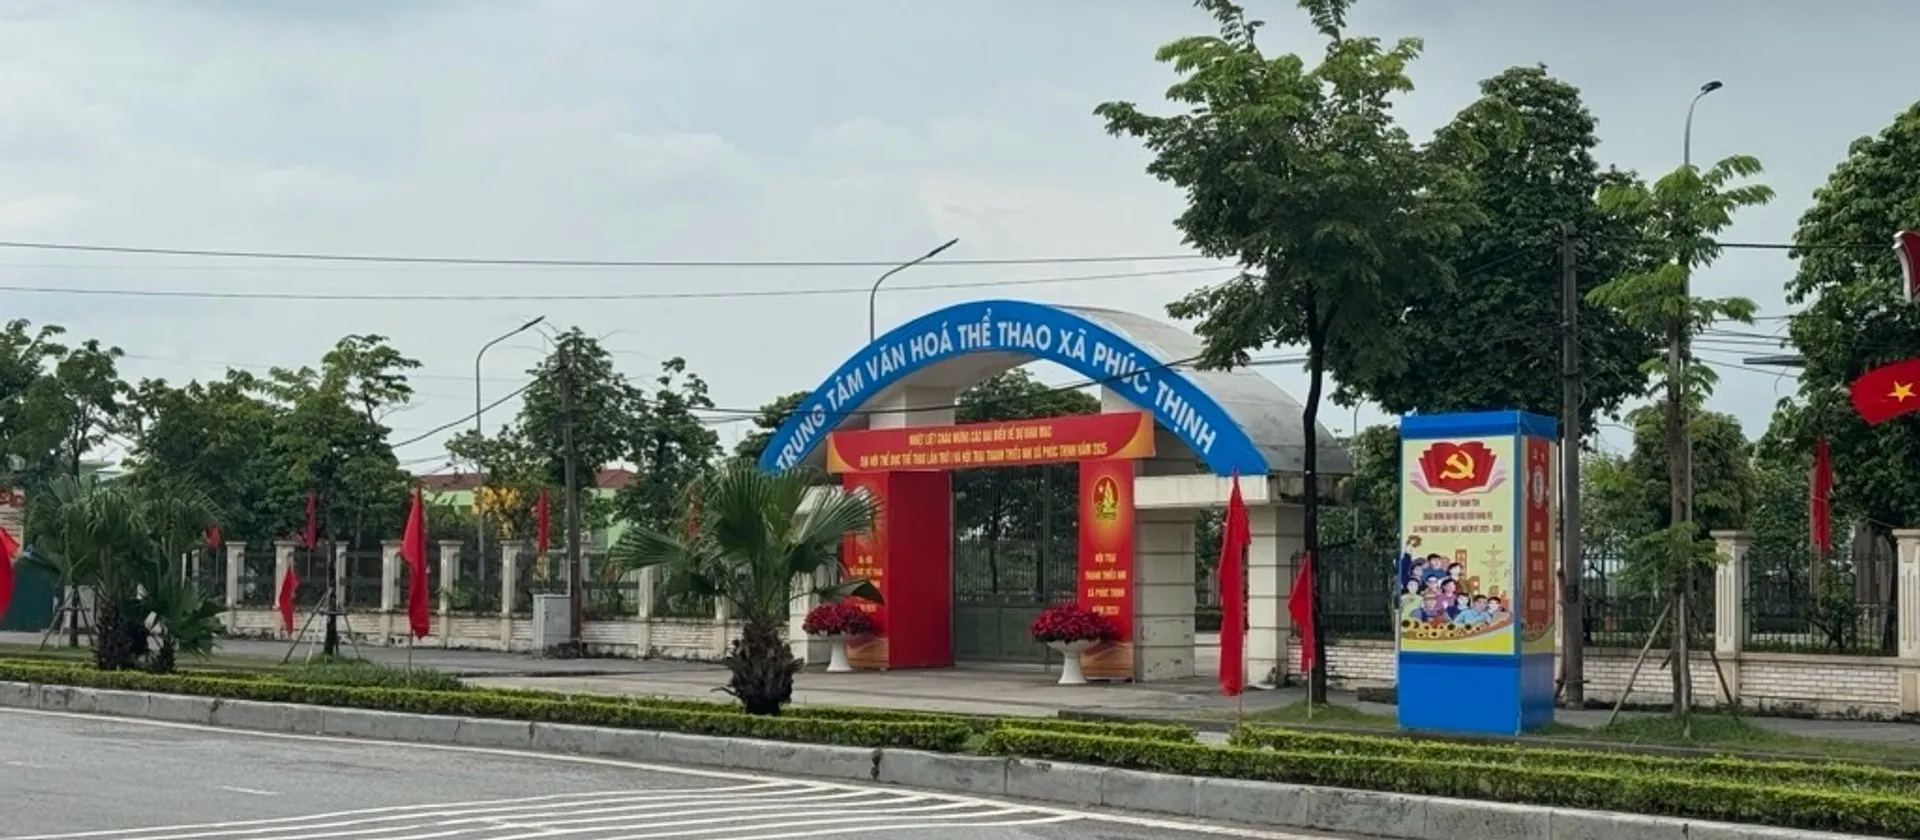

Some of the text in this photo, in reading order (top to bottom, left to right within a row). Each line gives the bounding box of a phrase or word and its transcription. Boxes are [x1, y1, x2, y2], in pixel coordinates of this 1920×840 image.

[775, 307, 1217, 472] TRUNG TÂM VĂN HOÁ THỂ THAO XÃ PHÚC THỊNH
